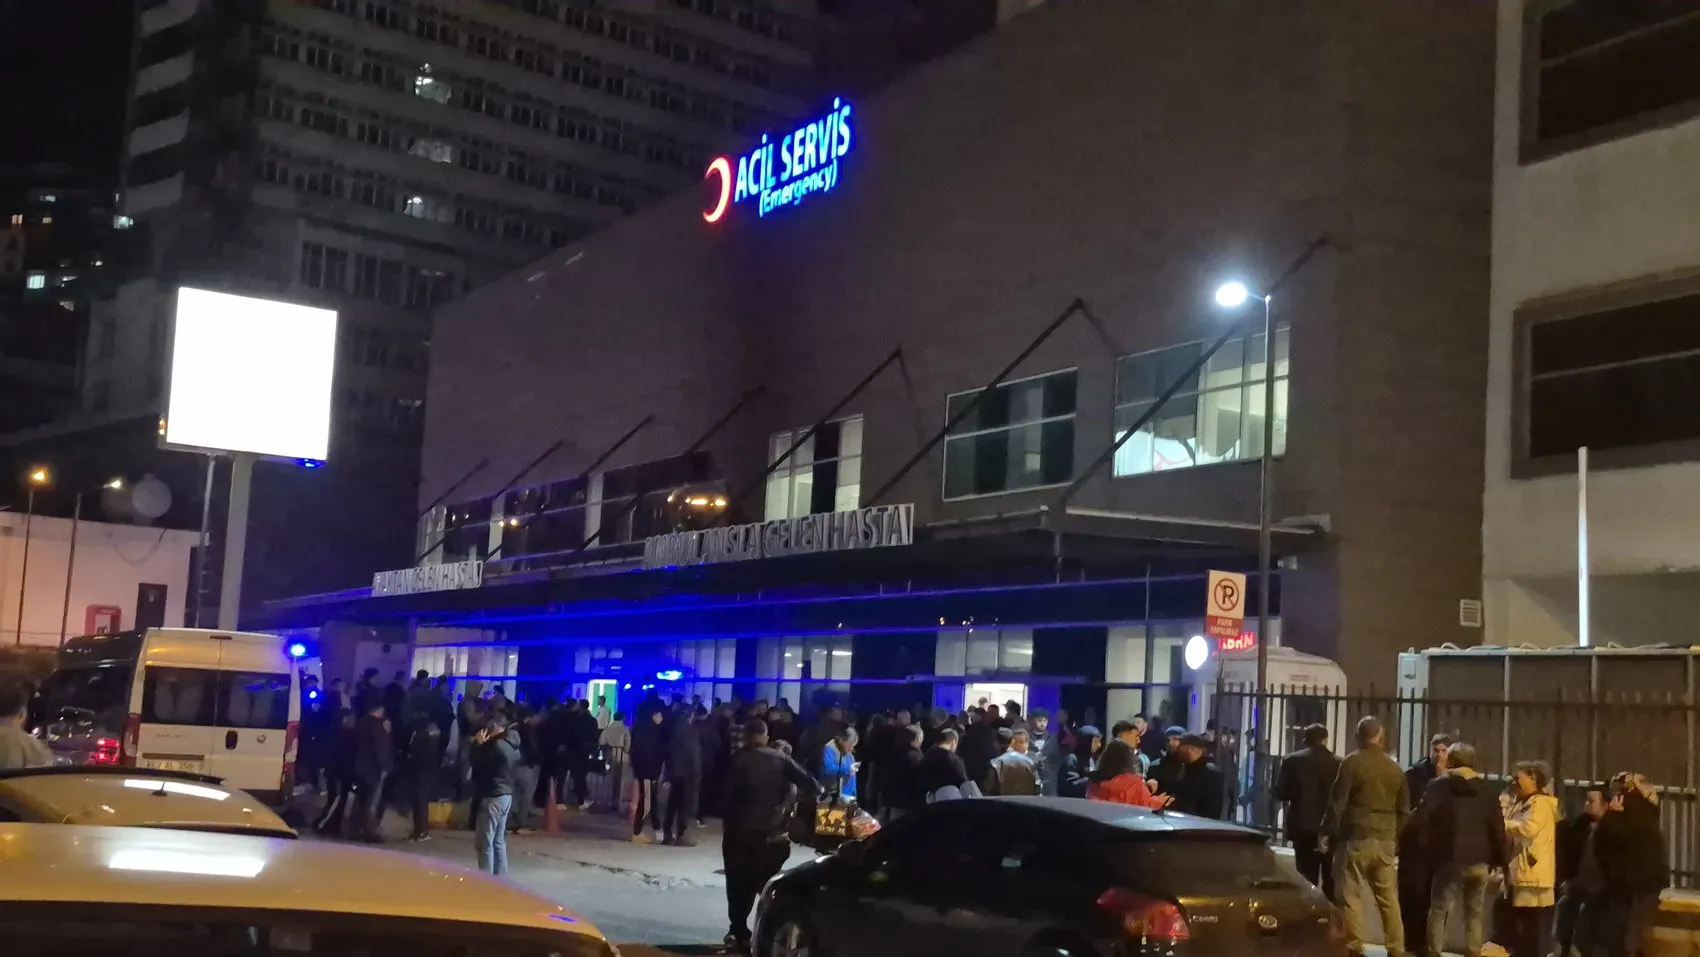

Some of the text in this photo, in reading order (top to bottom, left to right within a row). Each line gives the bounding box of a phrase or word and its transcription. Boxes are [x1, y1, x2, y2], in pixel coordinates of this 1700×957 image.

[734, 97, 851, 203] ACİL SERVİS
[758, 158, 838, 218] (Emergency)
